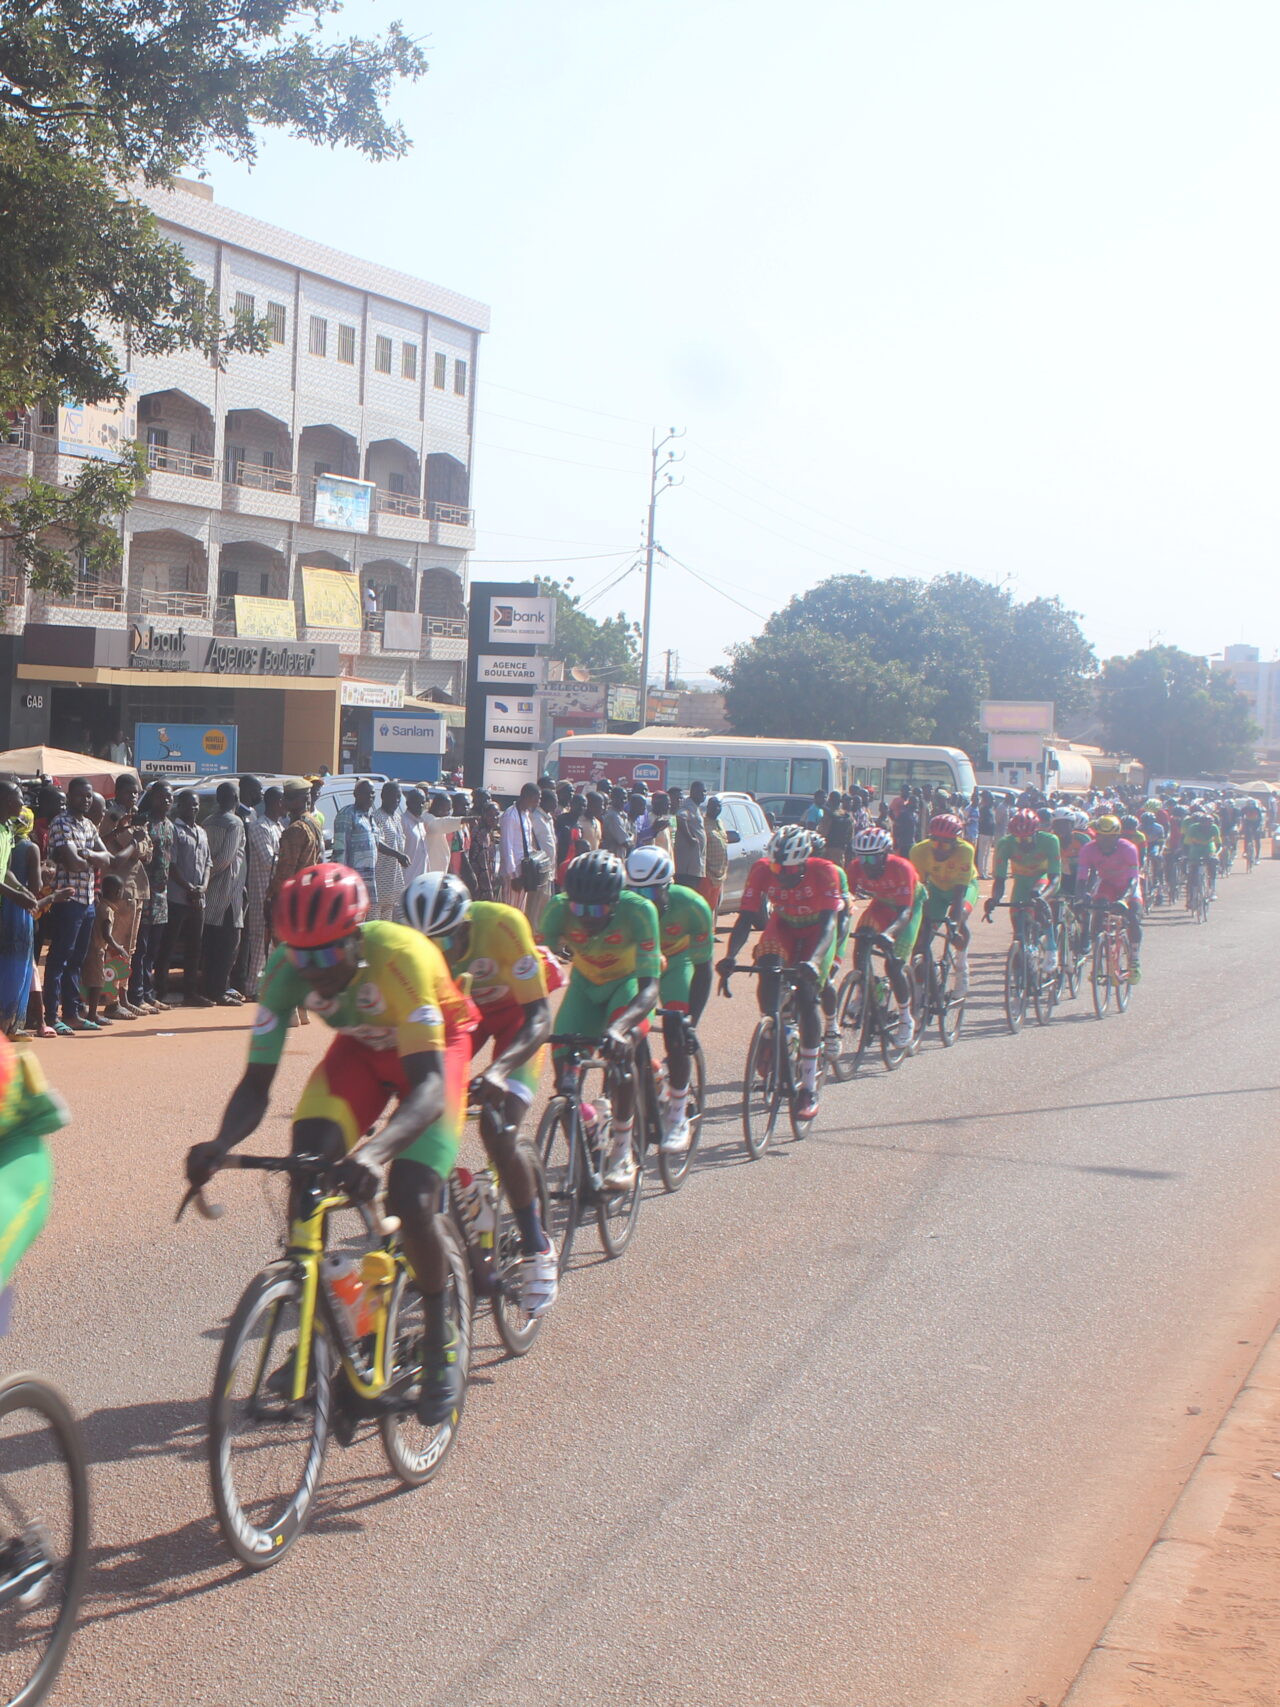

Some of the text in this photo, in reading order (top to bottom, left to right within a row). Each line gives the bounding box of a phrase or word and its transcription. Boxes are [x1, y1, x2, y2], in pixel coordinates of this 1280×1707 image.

[208, 639, 317, 672] Agence Boulevard
[484, 669, 535, 678] BOULEVARD
[26, 695, 43, 708] GAB
[392, 725, 434, 737] Sanlam
[492, 725, 534, 735] BANQUE
[493, 757, 528, 766] CHANGE
[145, 763, 191, 772] dynamil
[635, 769, 657, 777] NEW
